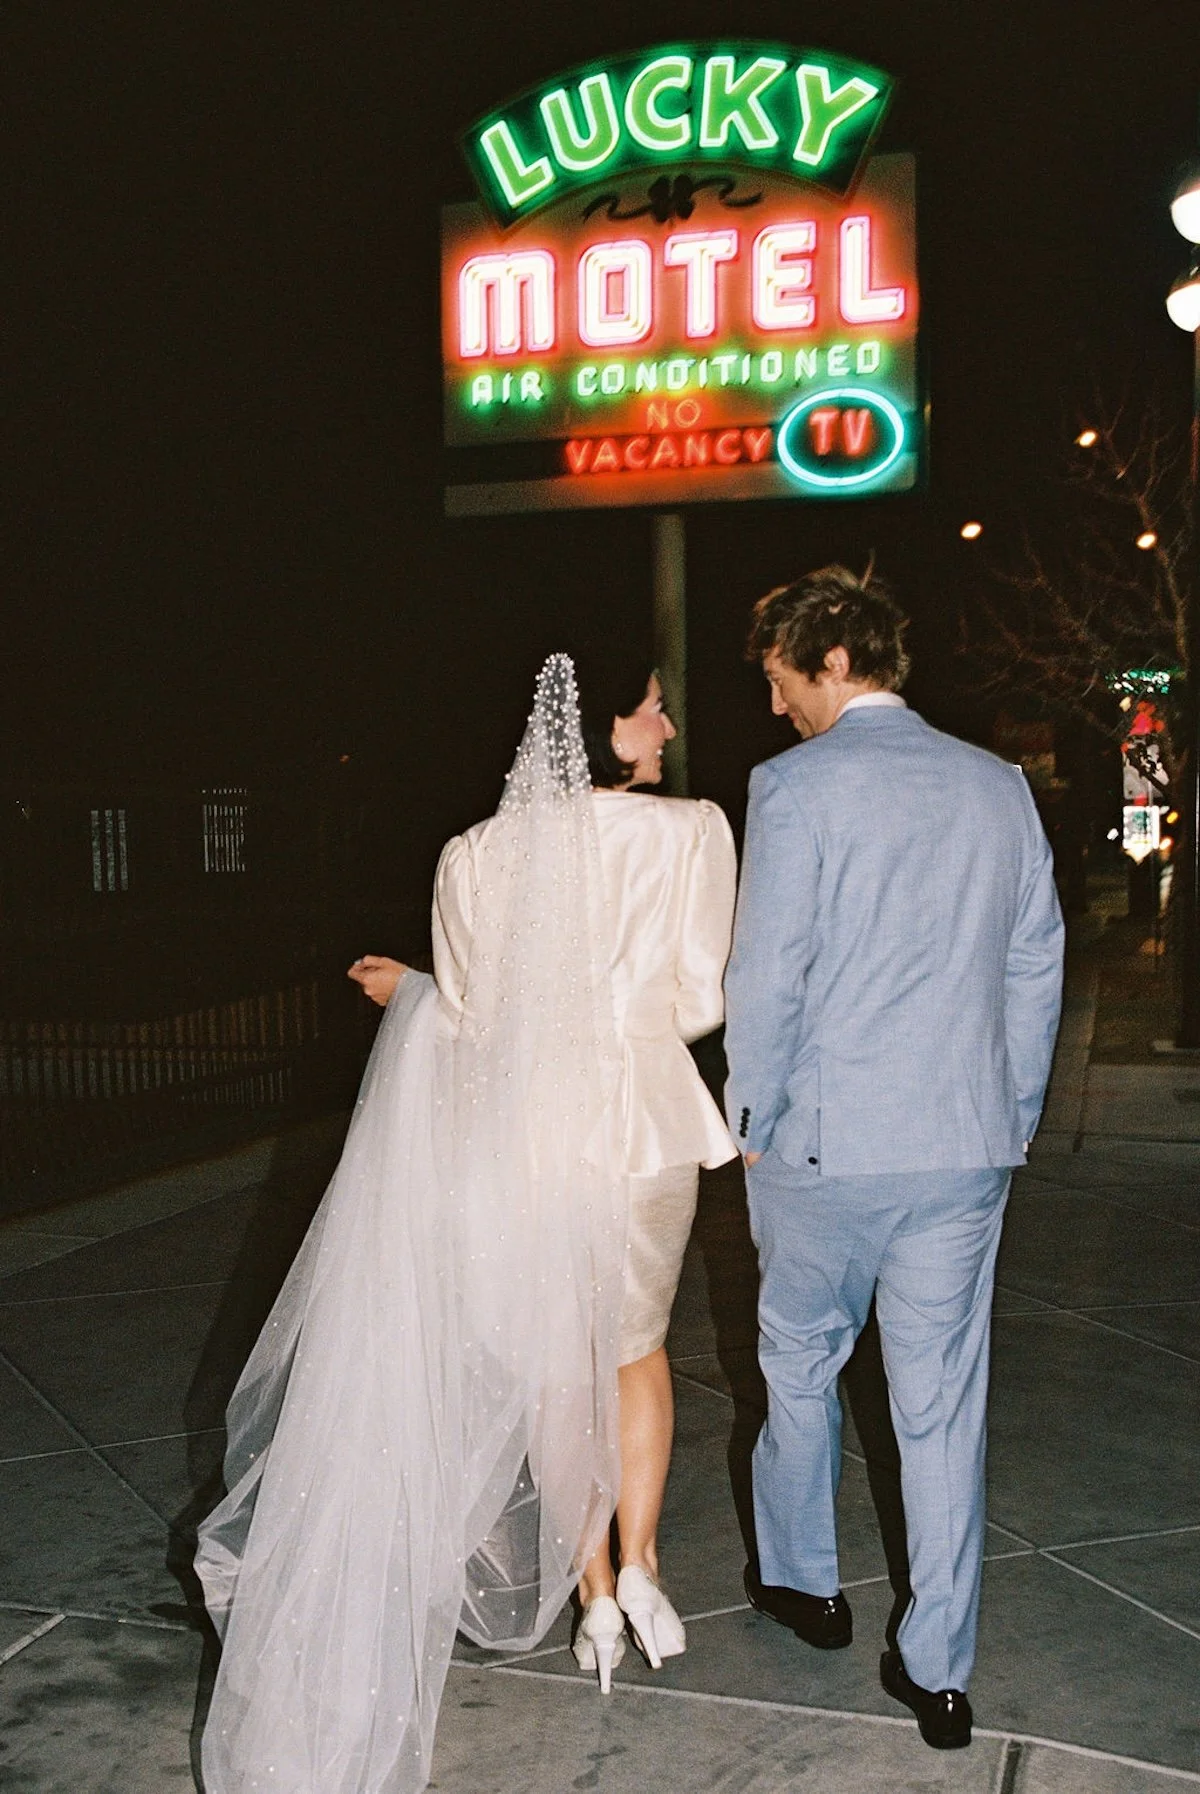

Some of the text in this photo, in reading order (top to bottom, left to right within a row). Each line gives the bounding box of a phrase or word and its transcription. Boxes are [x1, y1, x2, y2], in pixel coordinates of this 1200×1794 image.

[480, 55, 879, 208] LUCKY
[458, 215, 905, 358] MOTEL
[471, 340, 881, 406] AIR CONDITIONED
[646, 398, 701, 428] NO
[809, 408, 872, 456] TV
[565, 428, 772, 474] VACANCY
